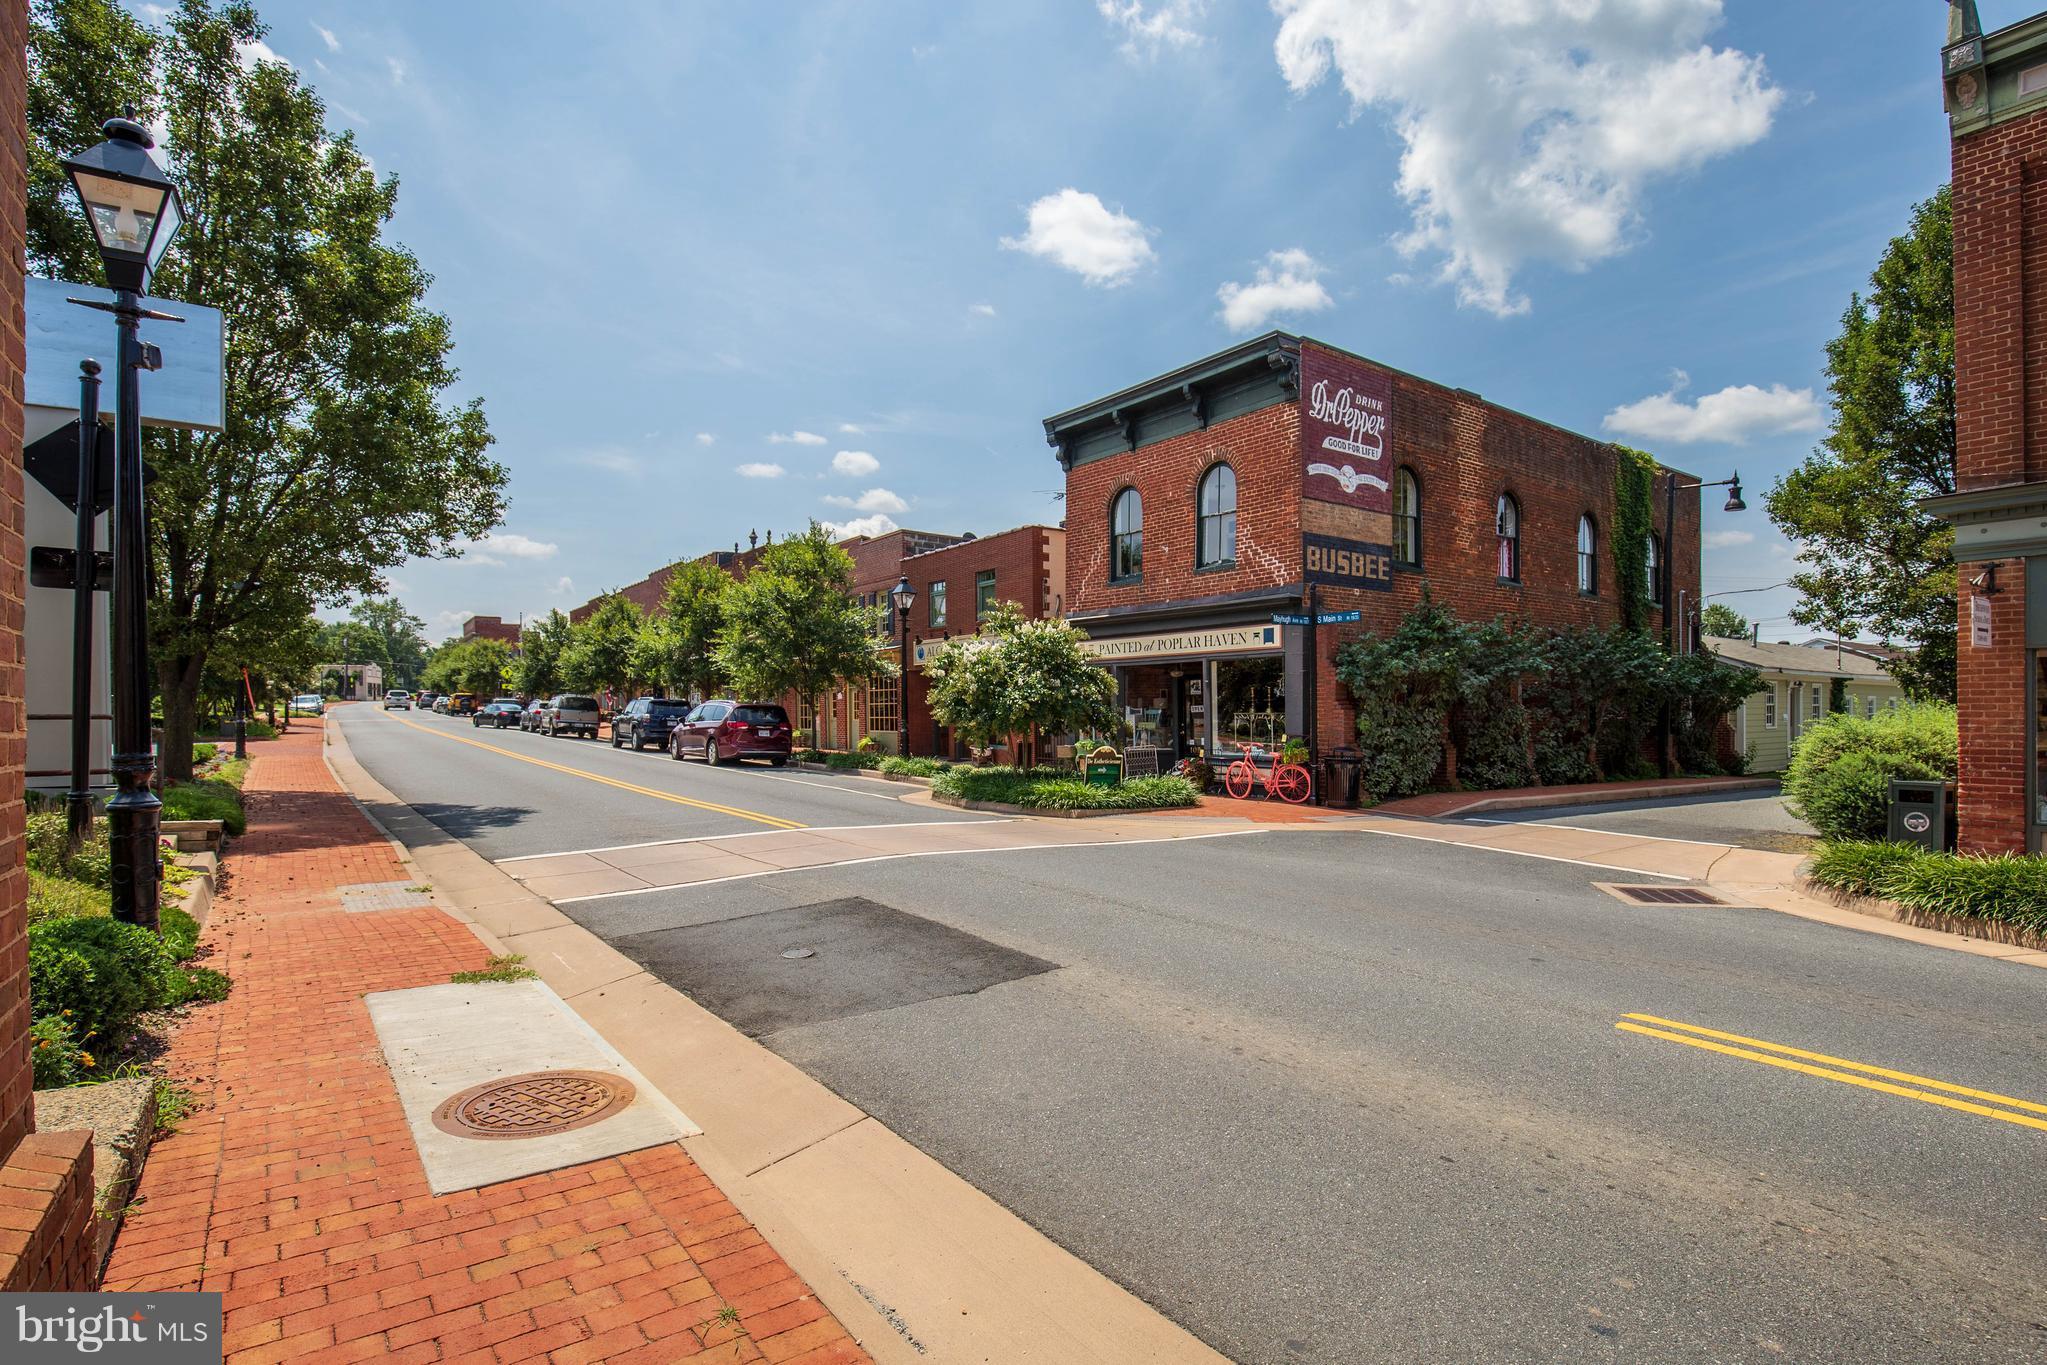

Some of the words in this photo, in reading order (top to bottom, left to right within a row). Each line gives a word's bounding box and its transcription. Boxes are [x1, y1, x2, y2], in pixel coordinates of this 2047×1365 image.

[1355, 394, 1383, 411] DRINK
[1333, 388, 1385, 443] Pepper
[1328, 438, 1347, 450] GOOD
[1347, 443, 1361, 454] FOR
[1361, 447, 1379, 459] LIFE!
[1306, 545, 1390, 580] BUSBEE
[1317, 615, 1322, 624] S
[1322, 614, 1336, 623] Main
[1099, 641, 1142, 655] PAINTED
[1157, 635, 1201, 651] POPLAR
[1204, 631, 1248, 648] HAVEN
